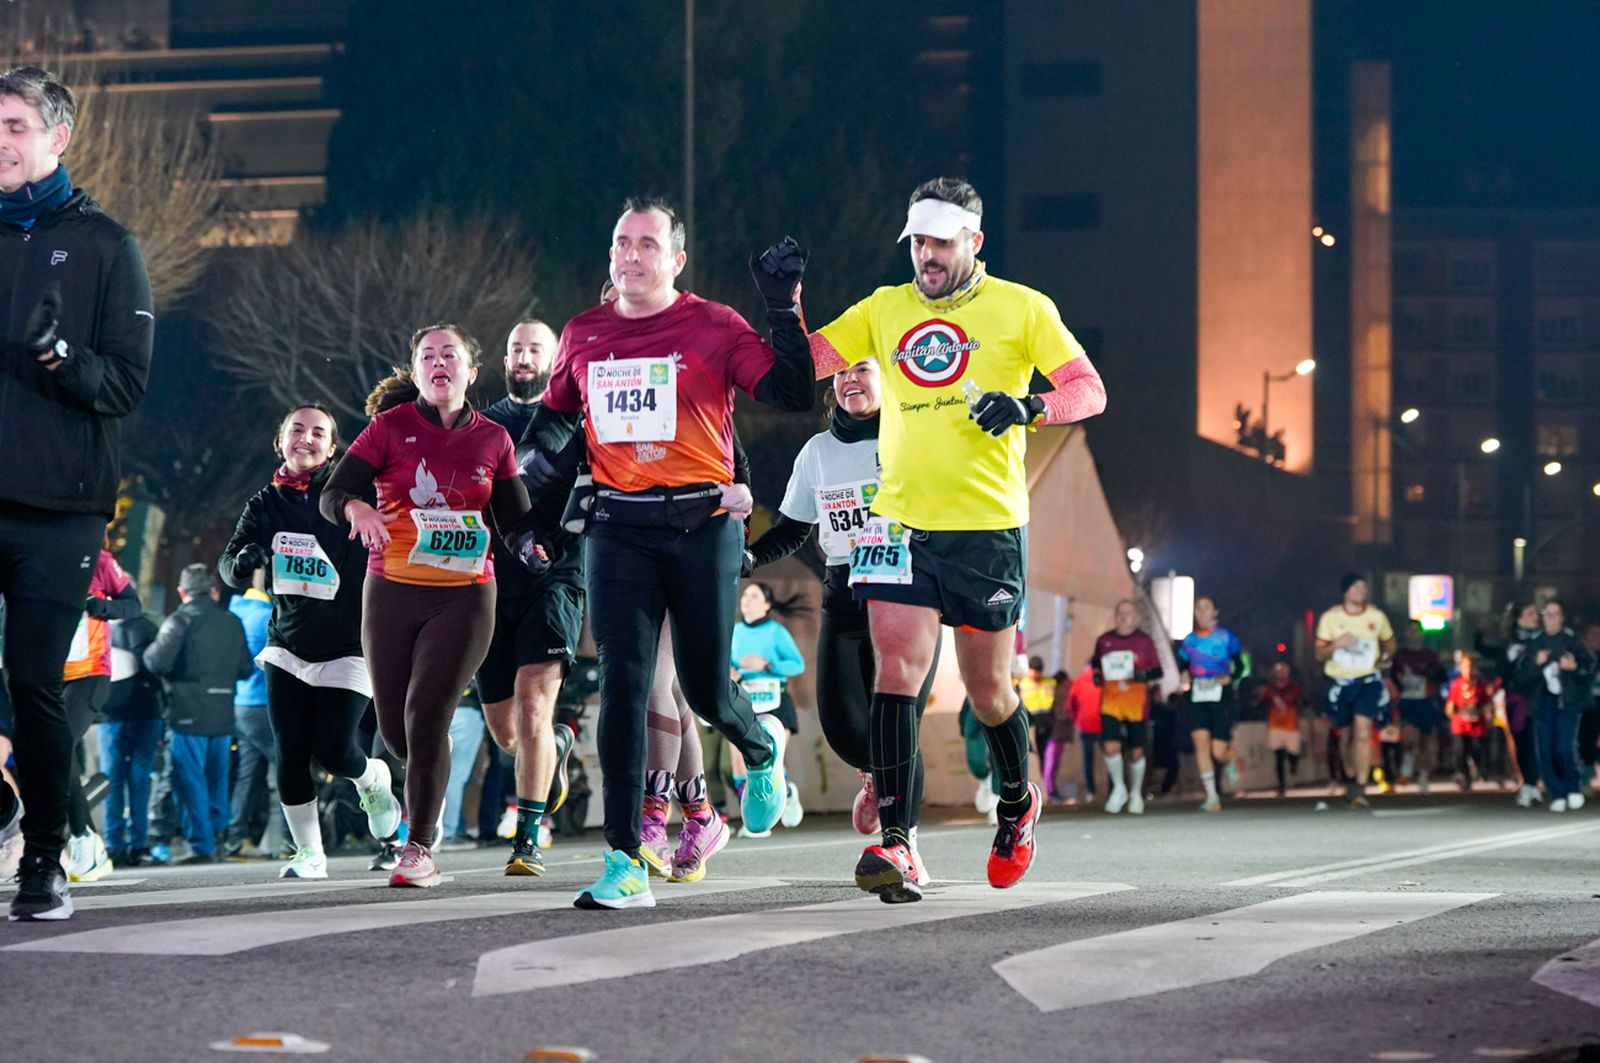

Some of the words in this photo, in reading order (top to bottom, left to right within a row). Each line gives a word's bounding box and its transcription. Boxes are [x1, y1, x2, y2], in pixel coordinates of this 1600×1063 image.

[597, 379, 613, 389] SAN
[605, 388, 657, 413] 1434
[846, 490, 854, 498] DE
[430, 530, 477, 550] 6205
[285, 555, 326, 576] 7836
